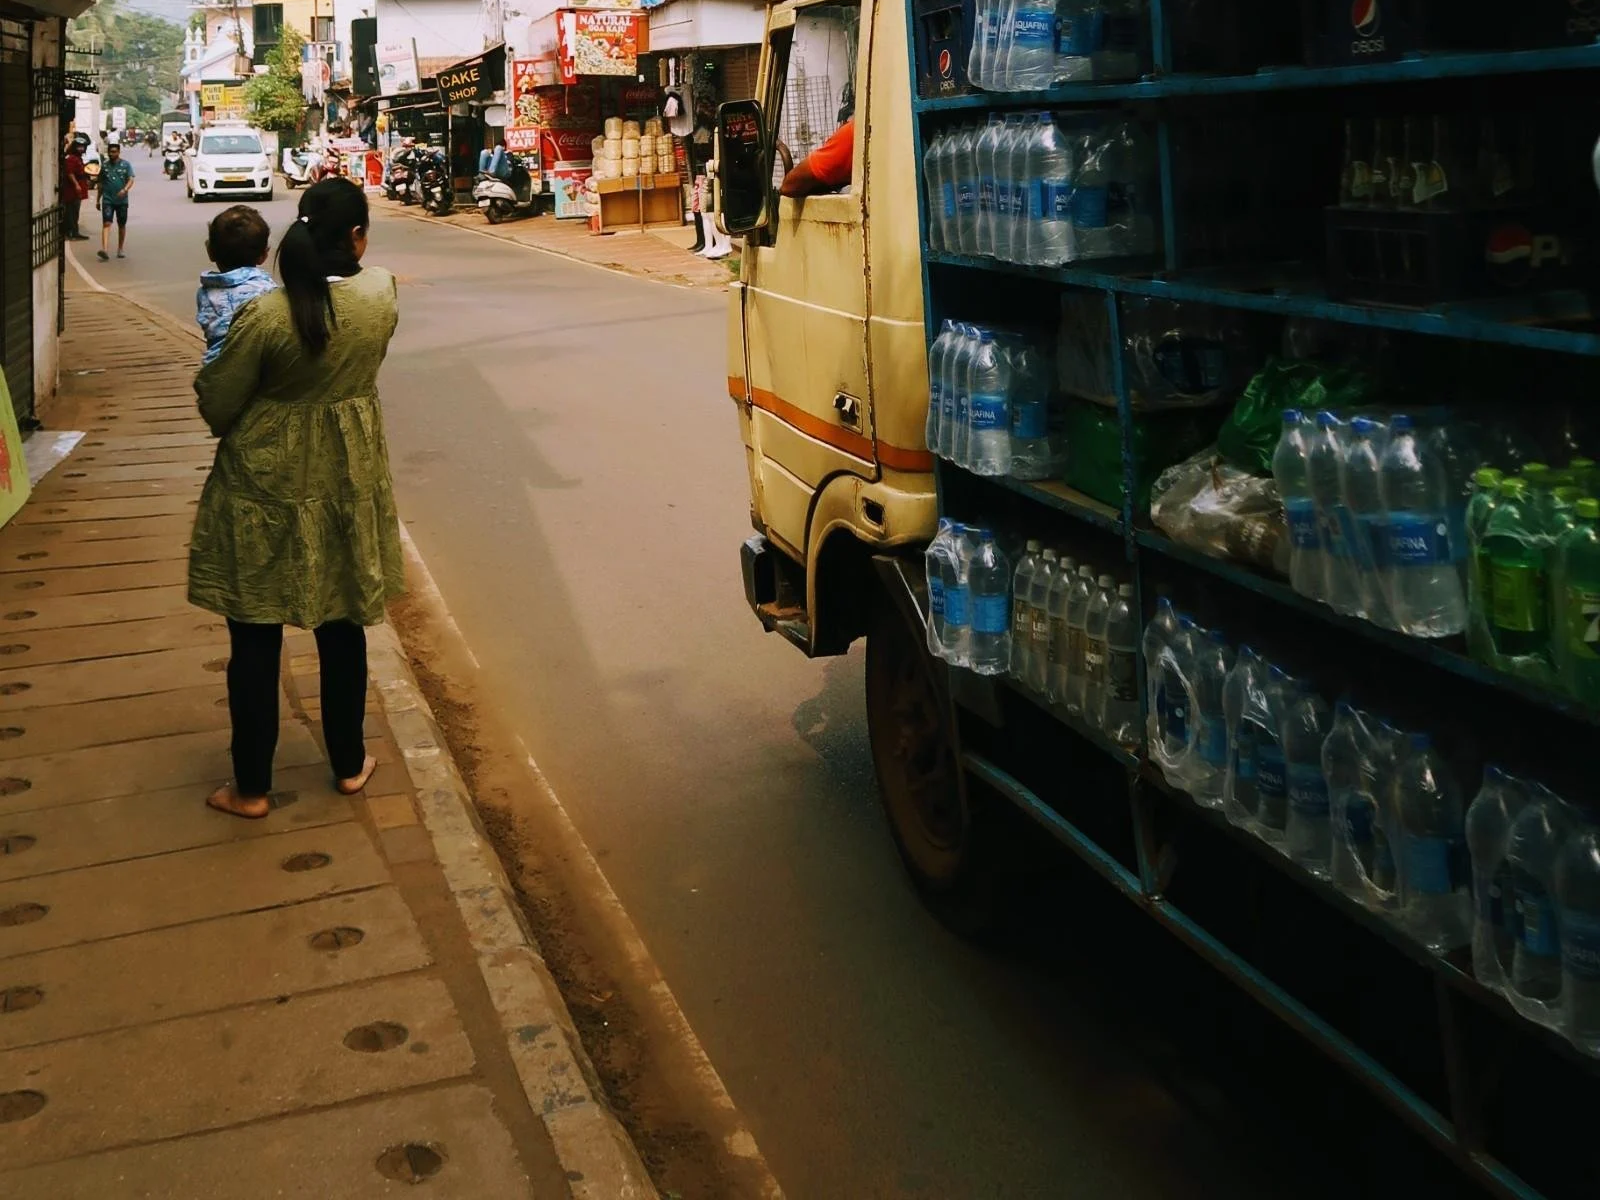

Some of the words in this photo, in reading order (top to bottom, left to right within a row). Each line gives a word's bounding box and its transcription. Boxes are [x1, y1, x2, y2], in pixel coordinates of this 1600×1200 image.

[579, 14, 633, 26] NATURAL
[606, 25, 627, 33] KAJU
[440, 68, 481, 89] CAKE
[449, 86, 478, 101] SHOP
